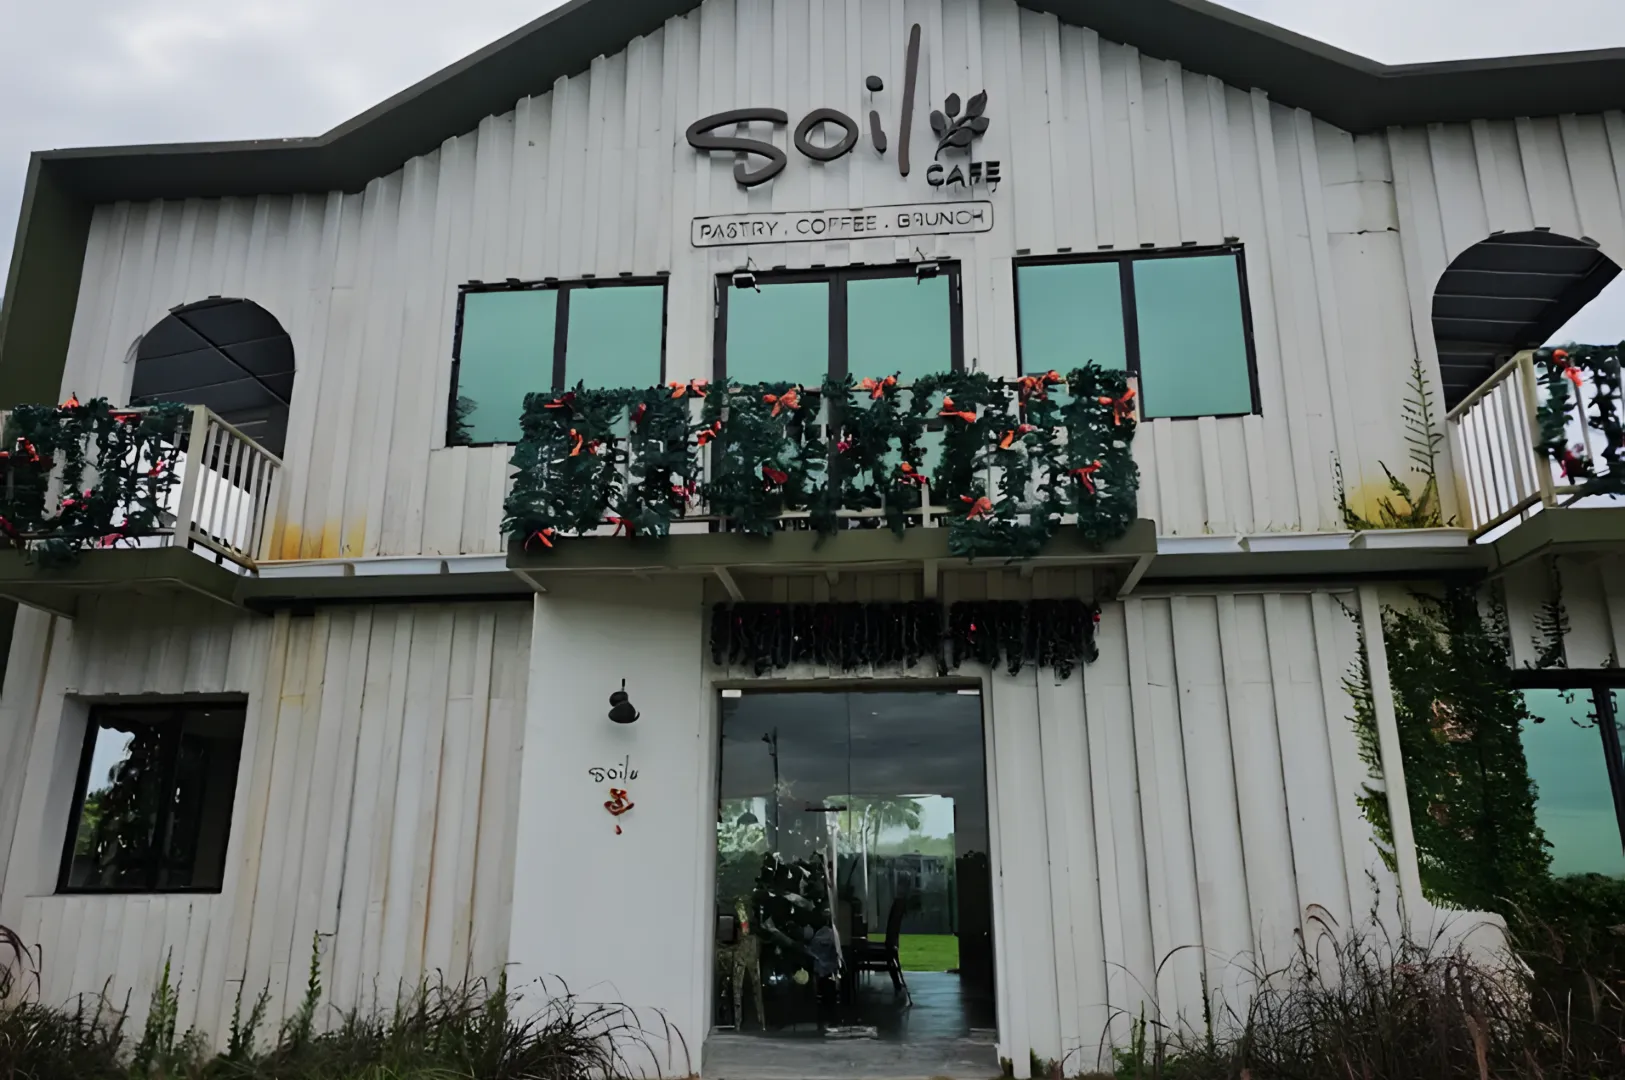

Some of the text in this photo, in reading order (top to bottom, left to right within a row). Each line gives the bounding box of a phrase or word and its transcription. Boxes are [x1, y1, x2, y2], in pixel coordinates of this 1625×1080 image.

[926, 160, 1001, 188] CAFE
[700, 221, 778, 239] PASTRY
[796, 215, 877, 235] COFFEE
